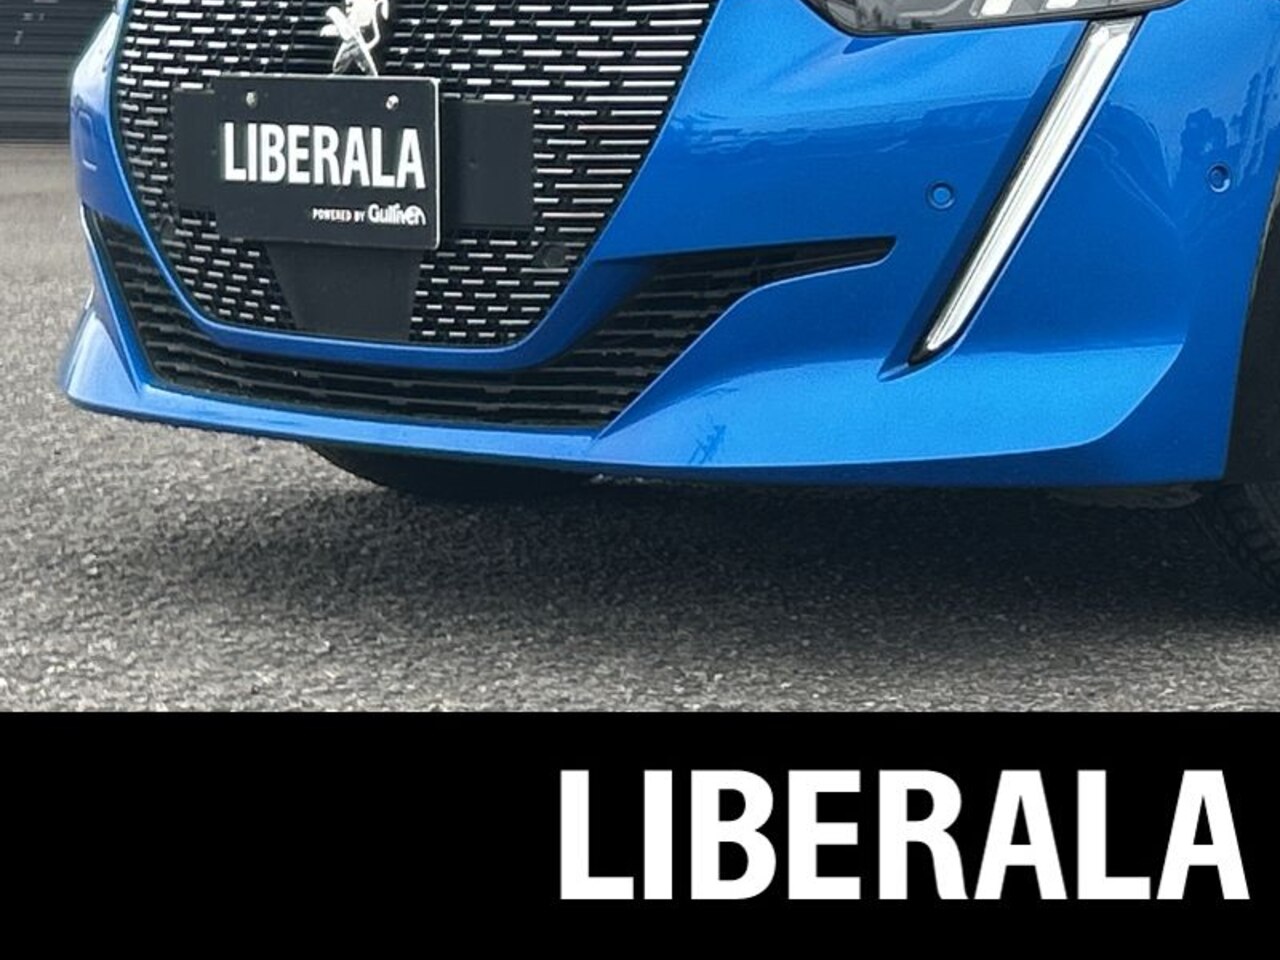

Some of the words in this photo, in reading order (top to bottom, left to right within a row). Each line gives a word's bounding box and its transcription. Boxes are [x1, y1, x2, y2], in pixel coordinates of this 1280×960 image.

[222, 122, 427, 189] LIBERALA
[312, 207, 352, 223] POWERED
[354, 210, 365, 223] BY
[367, 202, 427, 226] Gulliver
